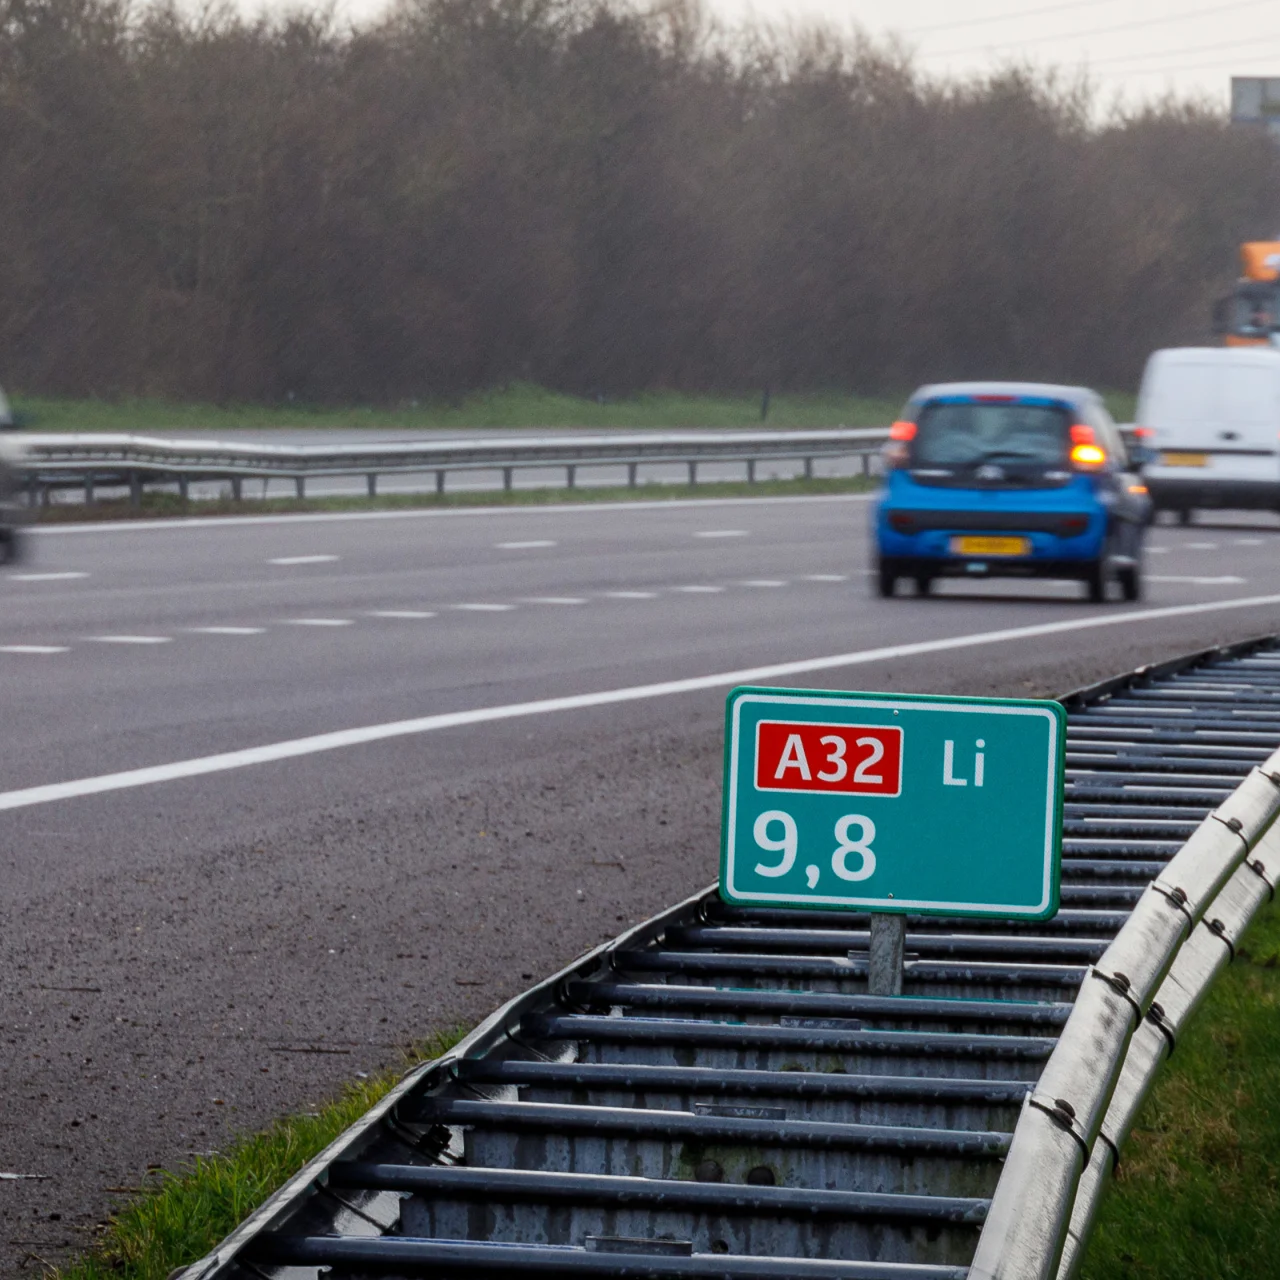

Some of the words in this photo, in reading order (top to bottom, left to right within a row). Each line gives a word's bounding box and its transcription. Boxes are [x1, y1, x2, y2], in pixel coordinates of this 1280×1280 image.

[773, 733, 885, 784] A32
[942, 738, 986, 787] Li
[752, 809, 878, 890] 9,8
